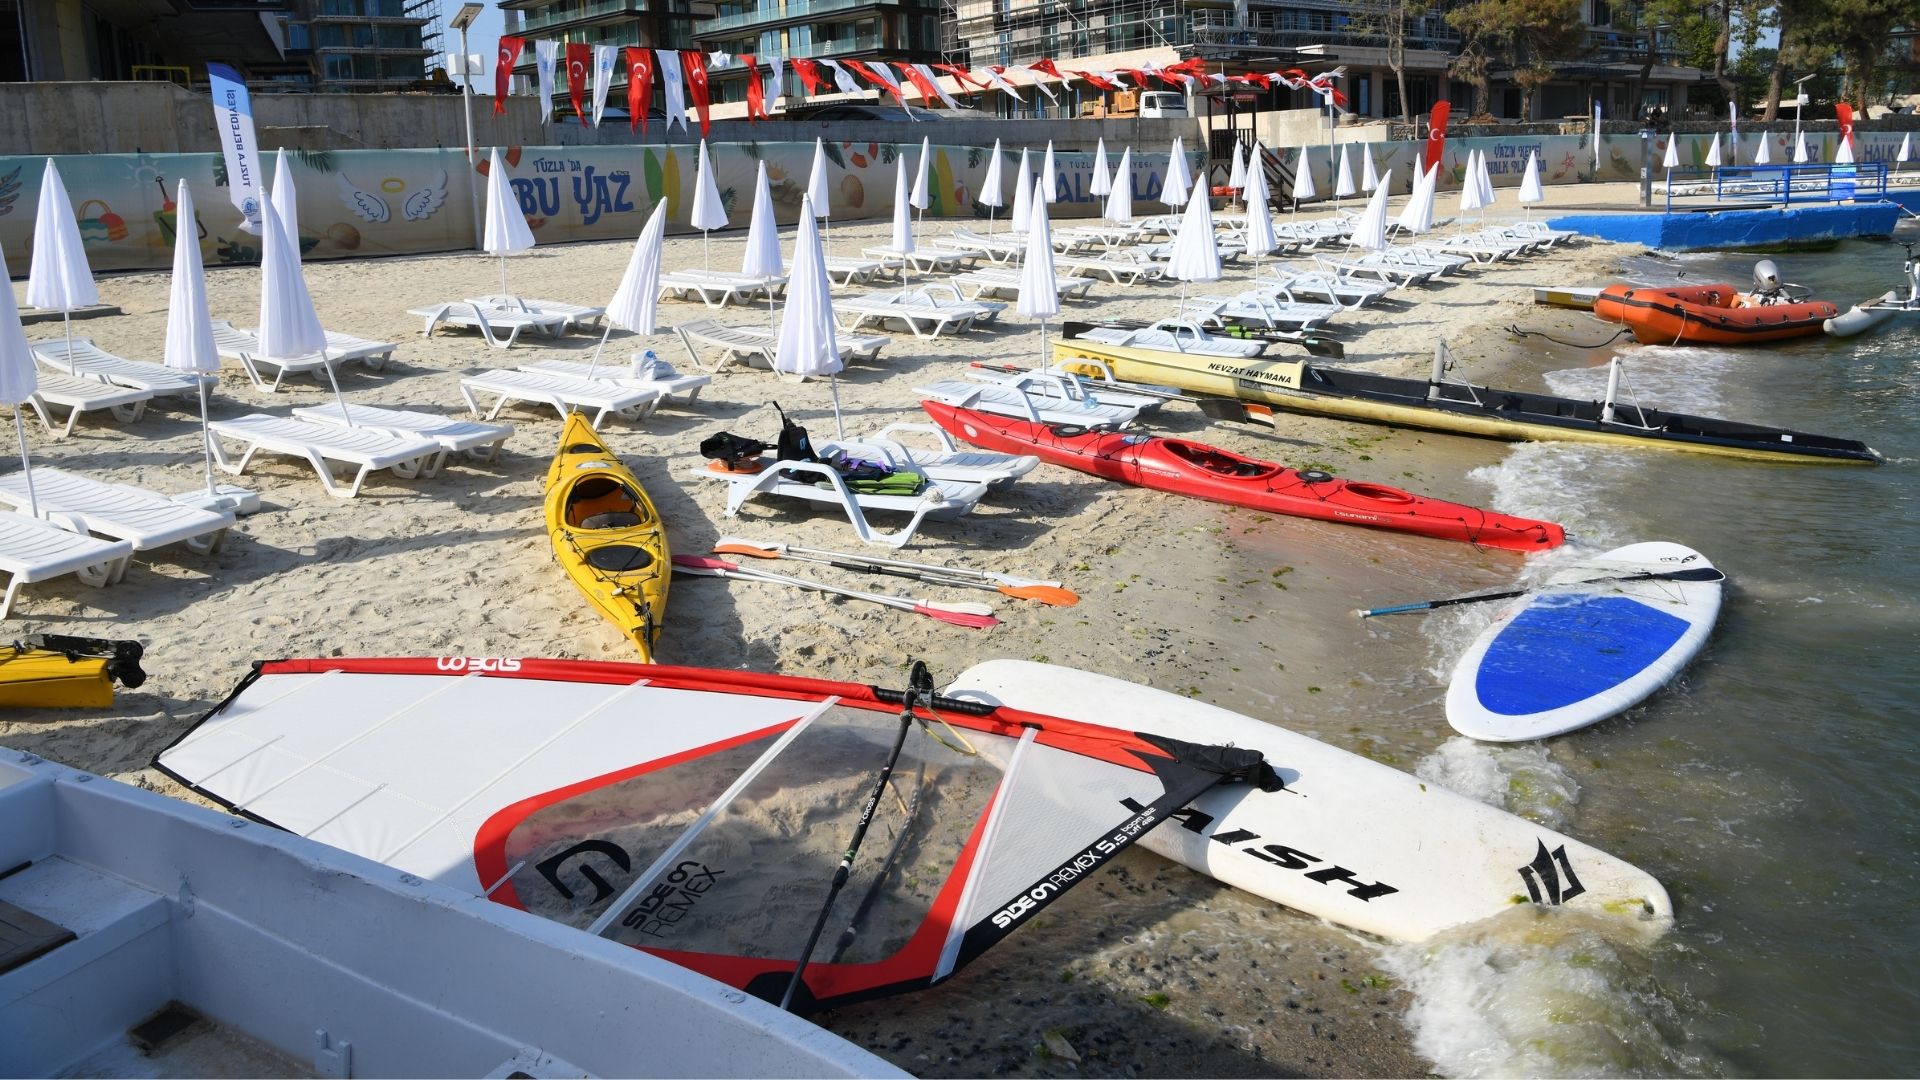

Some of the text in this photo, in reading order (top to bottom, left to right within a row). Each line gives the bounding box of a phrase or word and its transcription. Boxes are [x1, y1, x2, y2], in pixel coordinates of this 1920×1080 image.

[533, 157, 565, 173] TUZLA
[508, 165, 634, 225] BU YAZ
[1208, 362, 1292, 384] NEVZAT HAYMANA
[1121, 816, 1144, 832] boom
[1126, 824, 1142, 836] luff
[1049, 850, 1102, 888] REMEX
[1096, 834, 1128, 854] 5.5
[640, 865, 726, 938] REMEX
